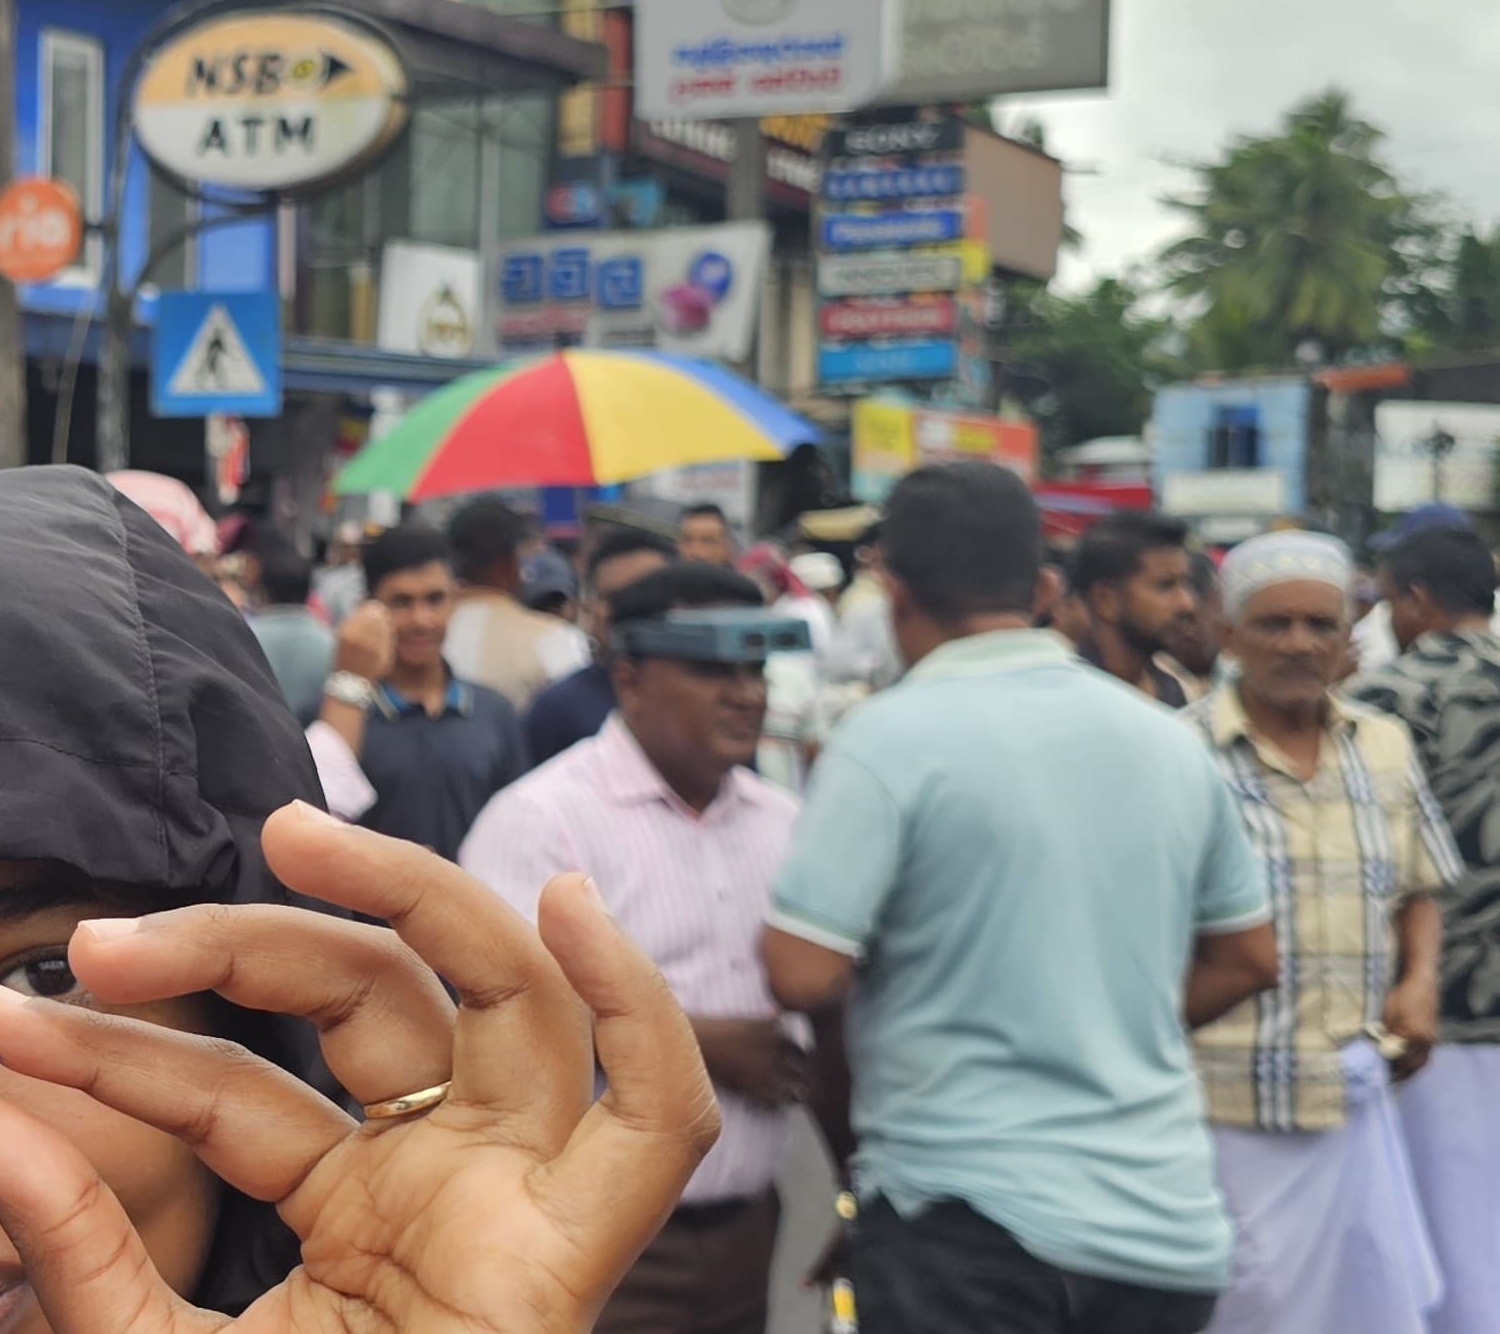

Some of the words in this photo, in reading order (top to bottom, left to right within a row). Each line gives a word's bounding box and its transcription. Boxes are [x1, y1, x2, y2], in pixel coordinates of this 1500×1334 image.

[184, 51, 283, 97] NSB
[198, 115, 315, 158] ATM
[845, 123, 941, 152] SONY
